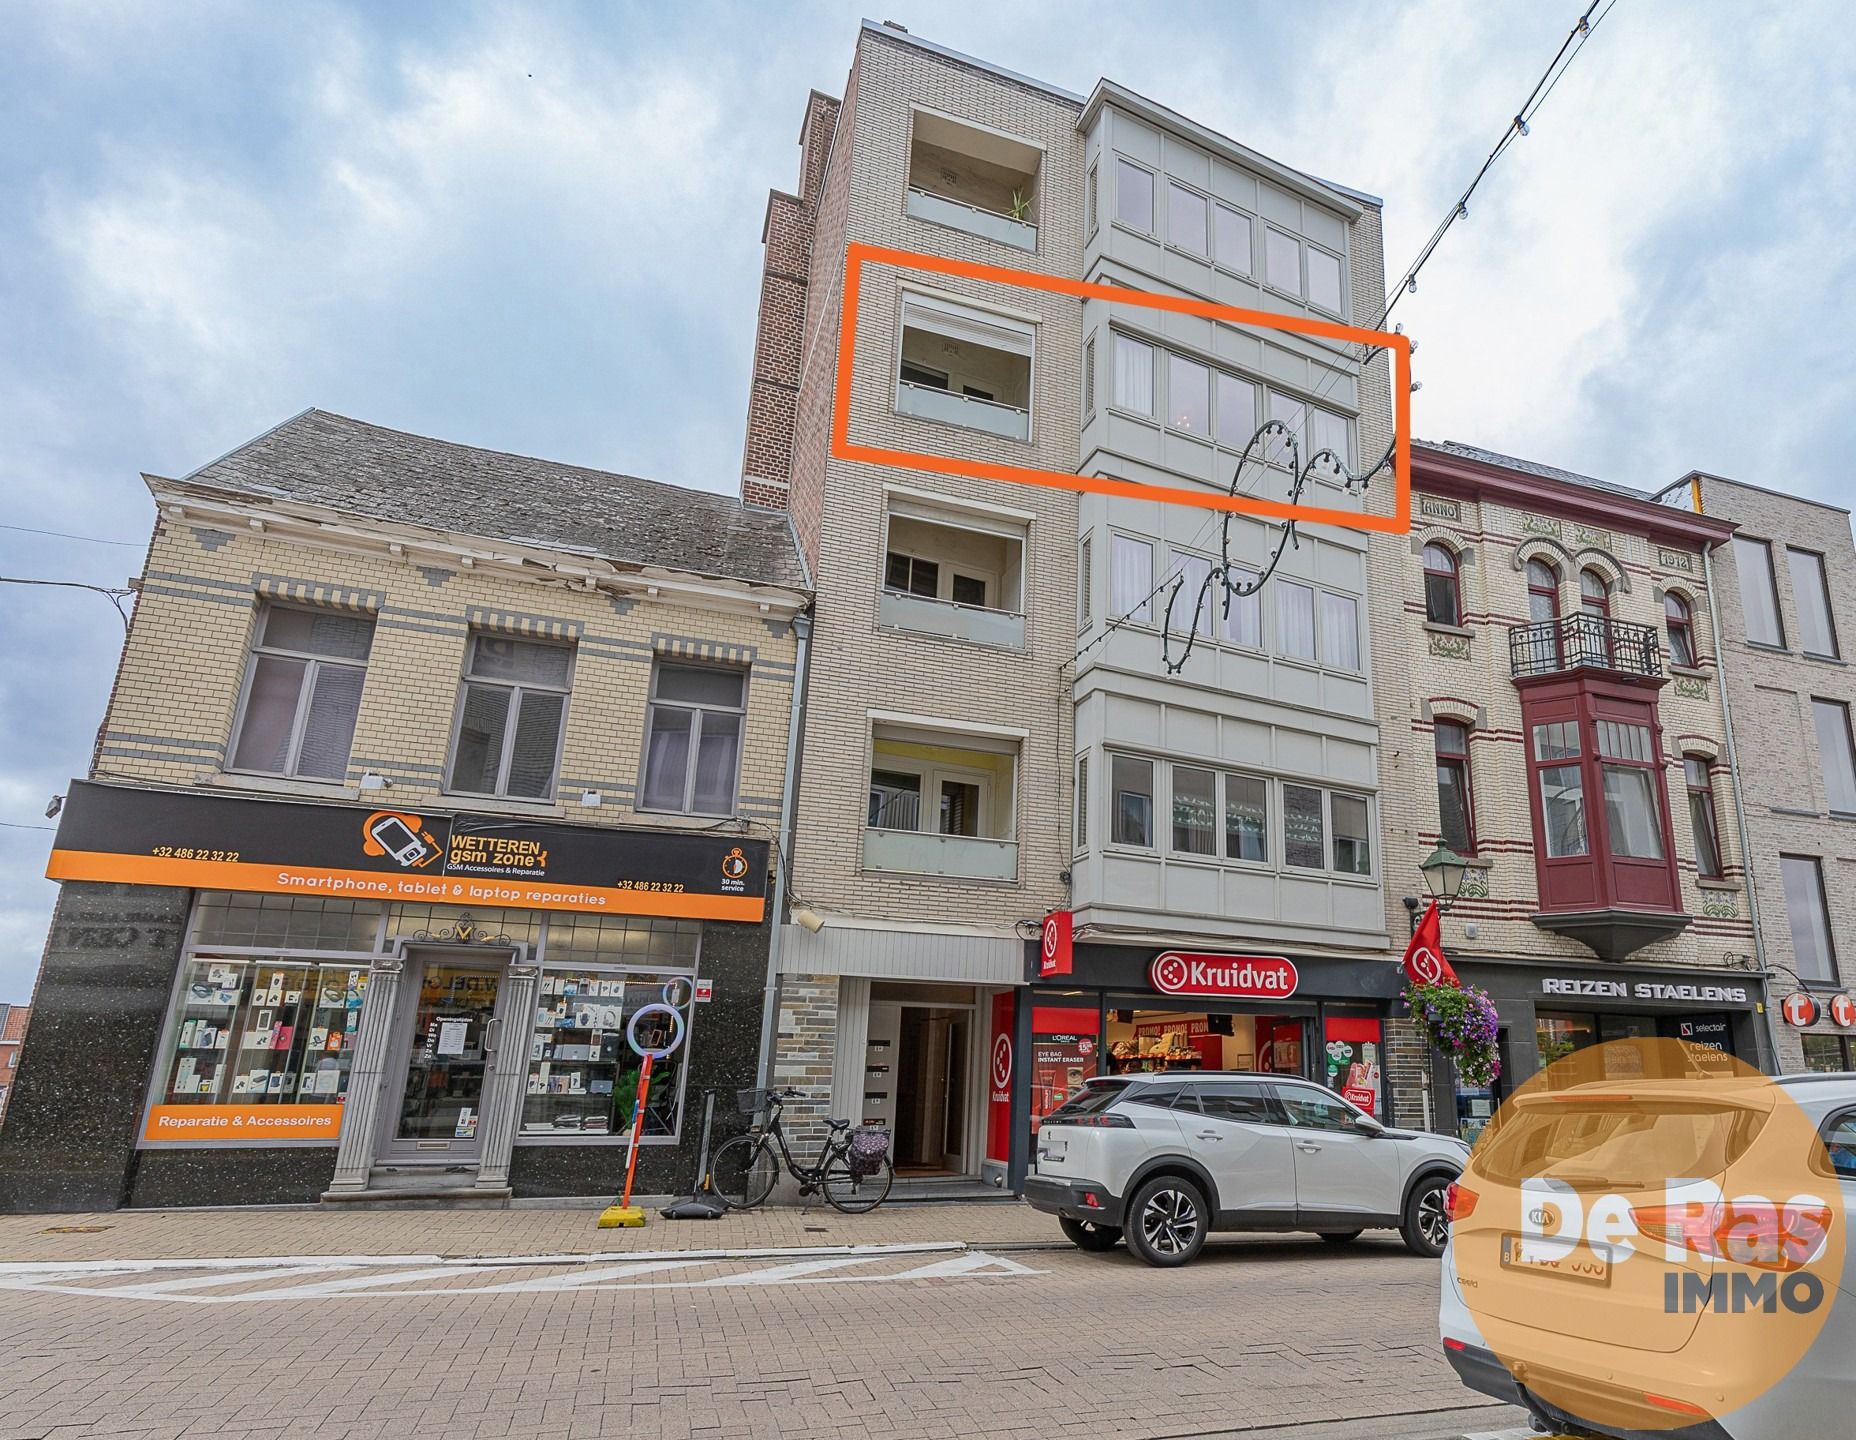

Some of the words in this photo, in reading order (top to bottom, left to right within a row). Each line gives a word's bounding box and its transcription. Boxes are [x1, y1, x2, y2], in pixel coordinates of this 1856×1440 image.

[1424, 501, 1456, 517] ANNO
[1662, 554, 1687, 568] 1912
[451, 834, 540, 854] WETTEREN
[152, 846, 172, 857] +32
[174, 848, 194, 858] 486
[195, 850, 210, 860] 22
[210, 850, 224, 861] 32
[226, 852, 240, 862] 22
[450, 849, 487, 864] gsm
[493, 852, 535, 866] zone
[464, 864, 505, 873] Accessoires
[512, 867, 545, 876] Reparatie
[277, 872, 392, 894] Smartphone,
[398, 880, 447, 895] tablet
[452, 884, 464, 896] &
[469, 885, 521, 901] laptop
[526, 890, 606, 906] reparaties
[617, 880, 632, 890] +32
[634, 881, 649, 891] 486
[650, 882, 660, 892] 22
[662, 883, 672, 892] 32
[674, 884, 684, 893] 22
[1190, 961, 1288, 990] Kruidvat
[1542, 978, 1628, 998] REIZEN
[1634, 982, 1747, 1002] STAELENS
[1163, 1024, 1188, 1034] PROMO!
[1695, 1022, 1727, 1032] selectair
[1690, 1041, 1722, 1051] reizen
[158, 1116, 228, 1128] Reparatie
[232, 1116, 243, 1126] &
[246, 1116, 332, 1126] Accessoires
[1531, 1210, 1550, 1223] KIA
